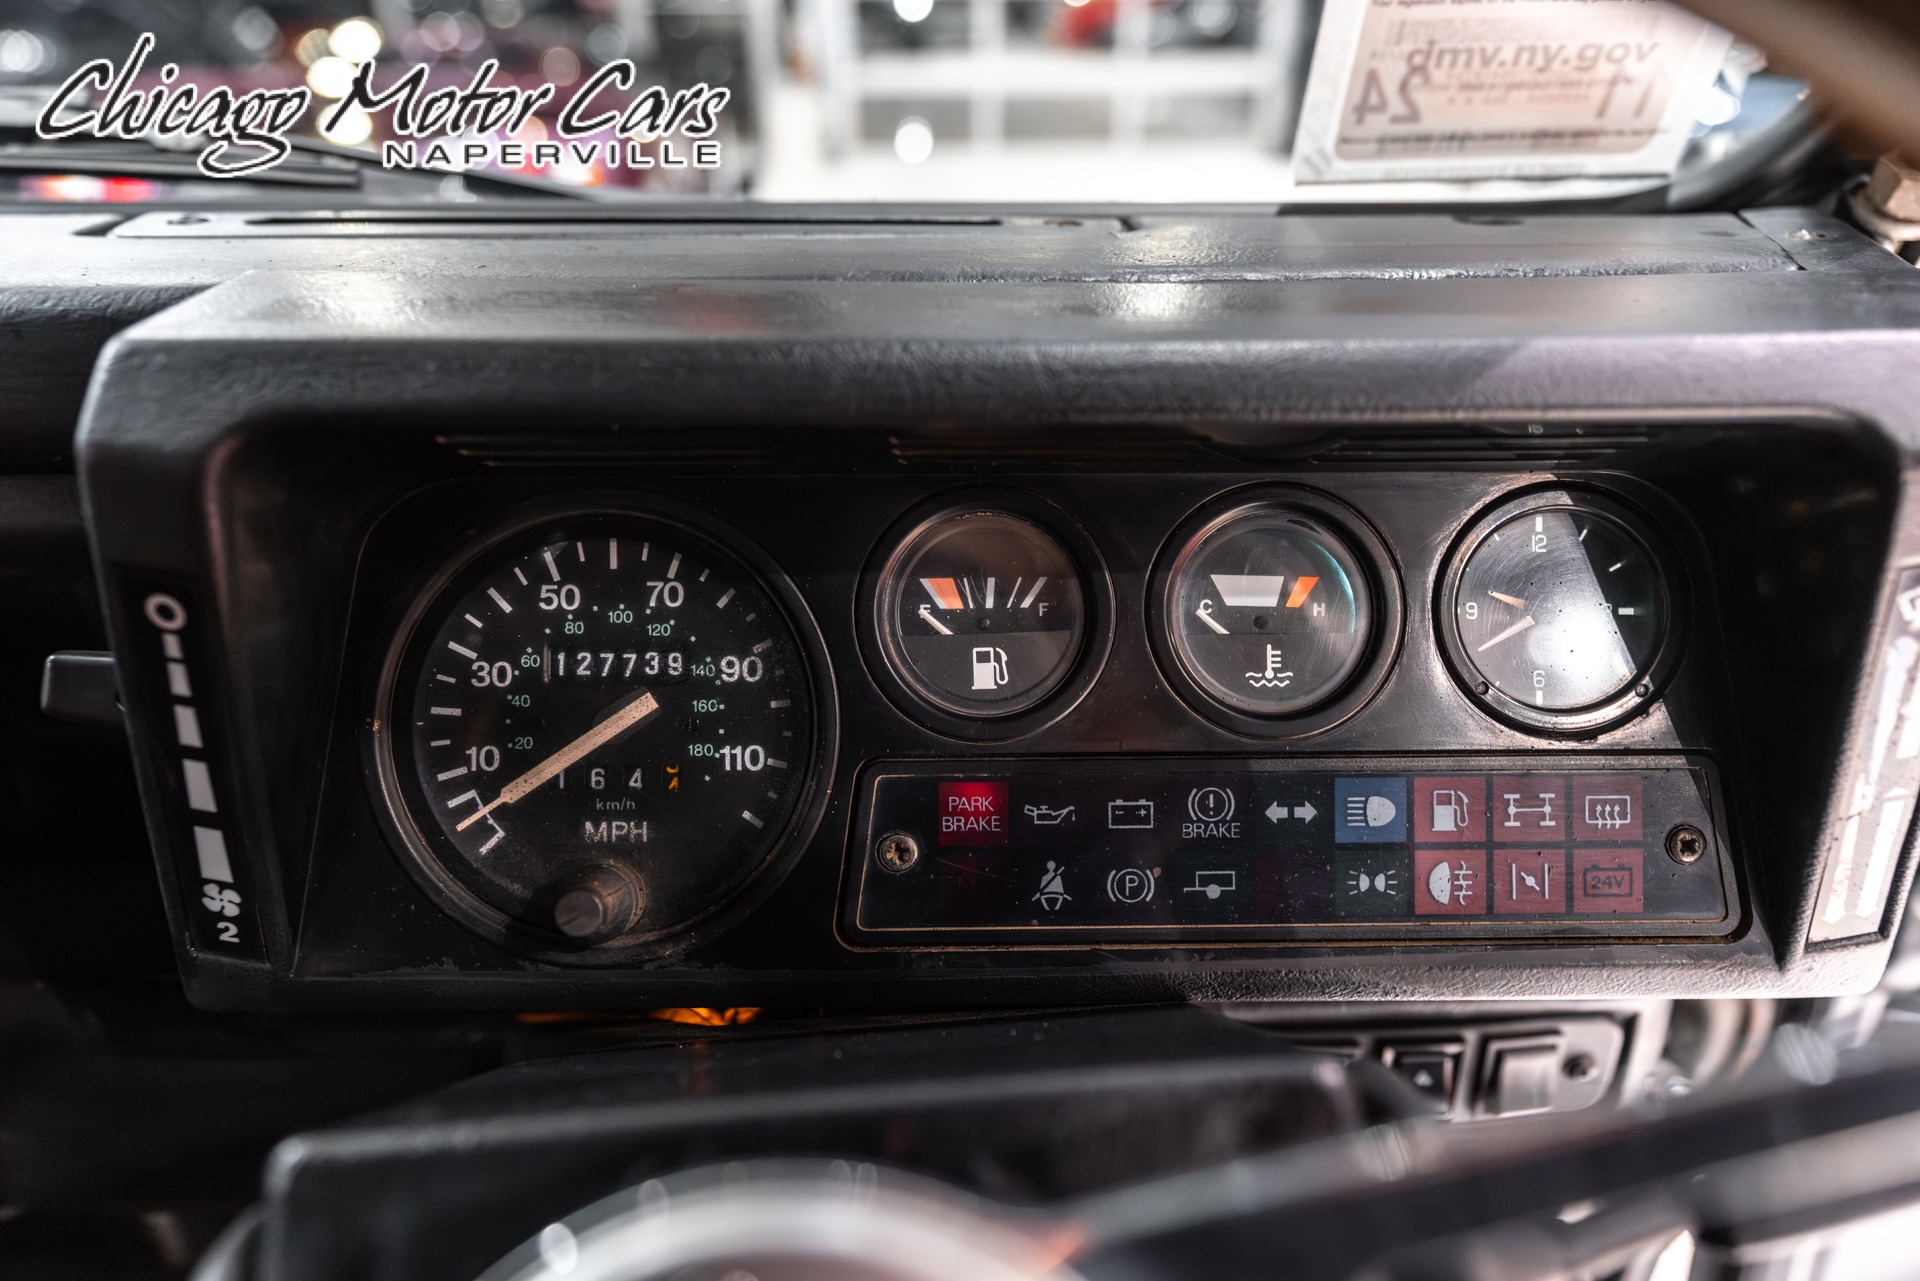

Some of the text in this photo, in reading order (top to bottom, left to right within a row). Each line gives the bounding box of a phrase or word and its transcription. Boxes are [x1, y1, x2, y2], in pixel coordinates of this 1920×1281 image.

[1407, 39, 1660, 73] dmv.ny.gov
[1531, 535, 1547, 552] 12
[539, 584, 581, 610] 50
[646, 581, 685, 607] 70
[1038, 602, 1049, 617] F
[1199, 599, 1213, 614] C
[1313, 602, 1326, 617] H
[1466, 602, 1478, 620] 9
[608, 611, 633, 624] 100
[564, 621, 585, 635] 80
[647, 623, 671, 637] 120
[520, 654, 541, 668] 60
[557, 652, 683, 677] 127739
[720, 656, 764, 682] 90
[470, 661, 513, 687] 30
[690, 664, 716, 678] 140
[1533, 670, 1545, 688] 6
[511, 694, 531, 708] 40
[692, 699, 718, 713] 160
[514, 736, 534, 750] 20
[688, 744, 714, 757] 180
[465, 745, 500, 771] 10
[719, 745, 765, 771] 110
[596, 798, 636, 811] km/h
[948, 796, 994, 812] PARK
[585, 821, 648, 843] MPH
[942, 816, 1002, 832] BRAKE
[1182, 823, 1241, 839] BRAKE
[1125, 875, 1139, 897] P
[1591, 875, 1624, 890] 24V
[217, 920, 240, 944] 2
